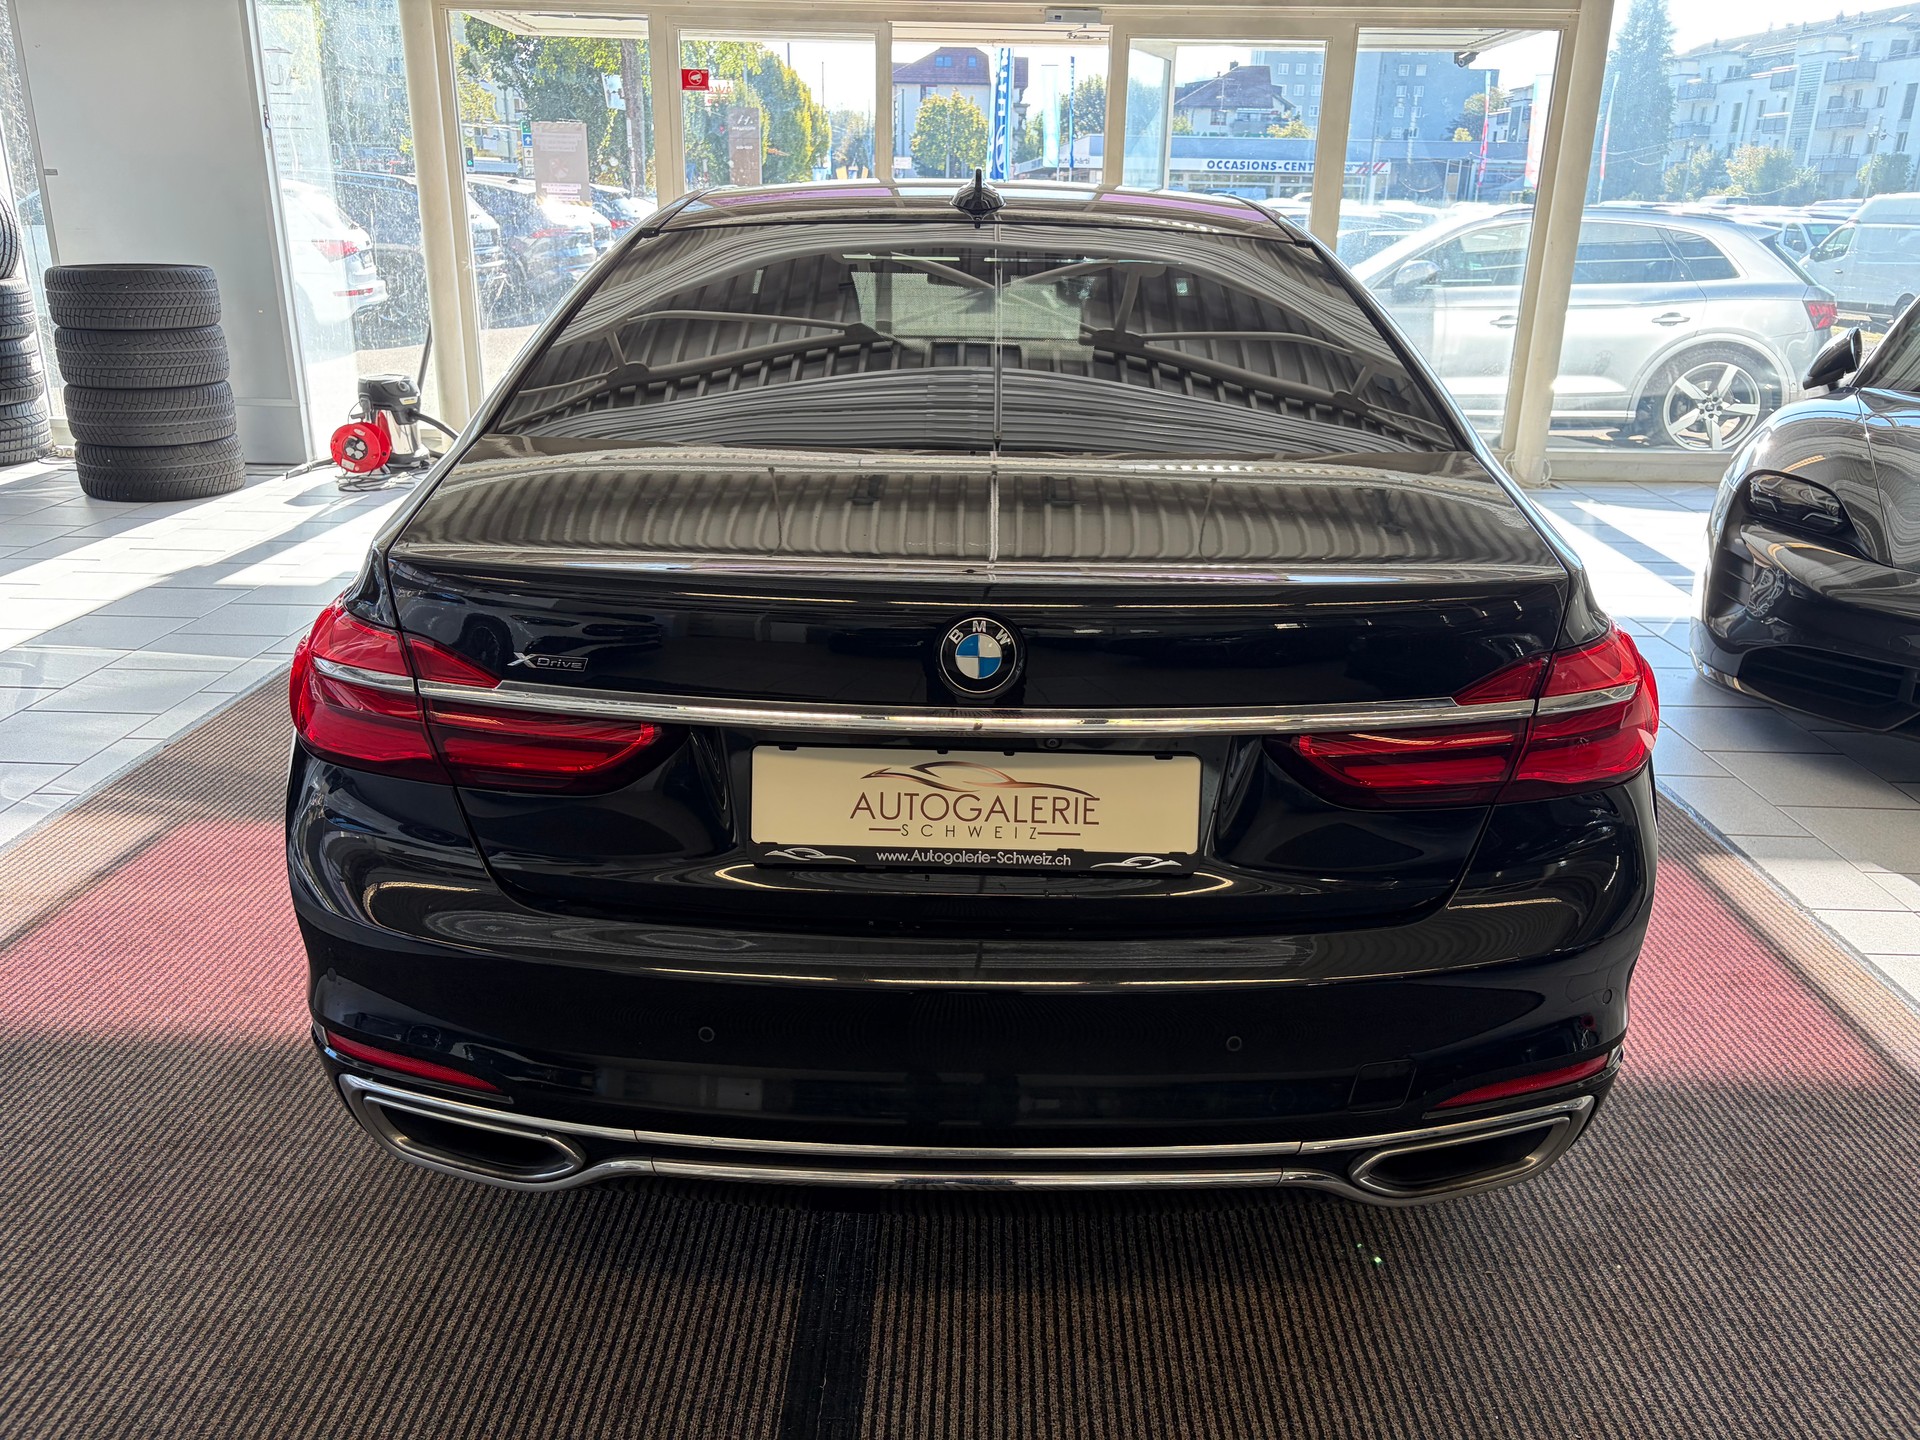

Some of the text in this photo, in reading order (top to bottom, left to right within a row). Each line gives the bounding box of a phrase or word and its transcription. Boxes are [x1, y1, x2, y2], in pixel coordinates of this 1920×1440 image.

[948, 620, 1012, 646] BMW
[849, 791, 1101, 825] AUTOGALERIE
[901, 823, 1037, 840] SCHWEIZ
[876, 849, 1071, 866] www.Autogalerie-Schweiz.ch
